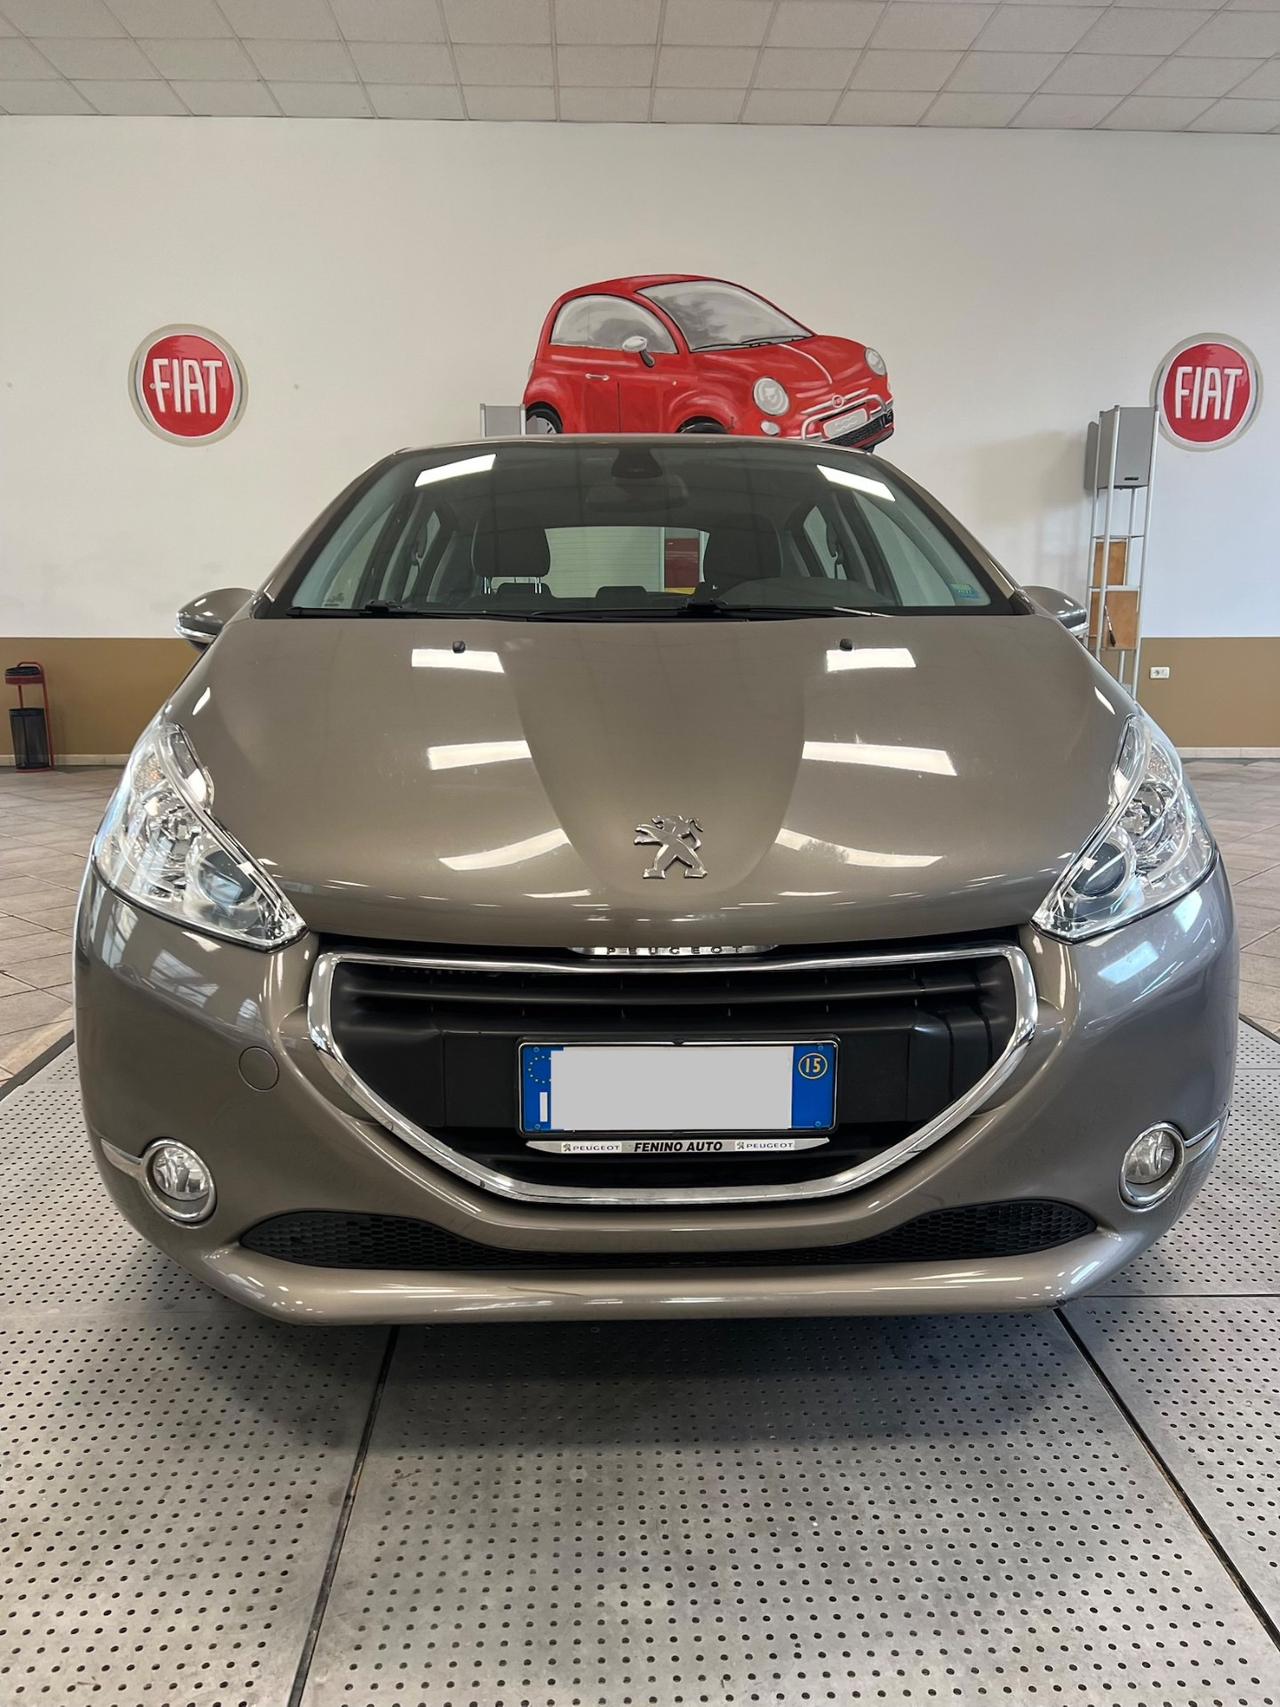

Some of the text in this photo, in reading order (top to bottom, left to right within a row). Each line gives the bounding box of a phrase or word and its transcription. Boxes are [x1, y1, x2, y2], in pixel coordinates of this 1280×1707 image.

[149, 358, 223, 415] FIAT
[1175, 366, 1243, 420] FIAT
[606, 946, 742, 956] PEUGEOT
[804, 1057, 822, 1074] 15
[572, 1141, 794, 1152] PEUGEOT FENINO AUTO PEUGEOT
